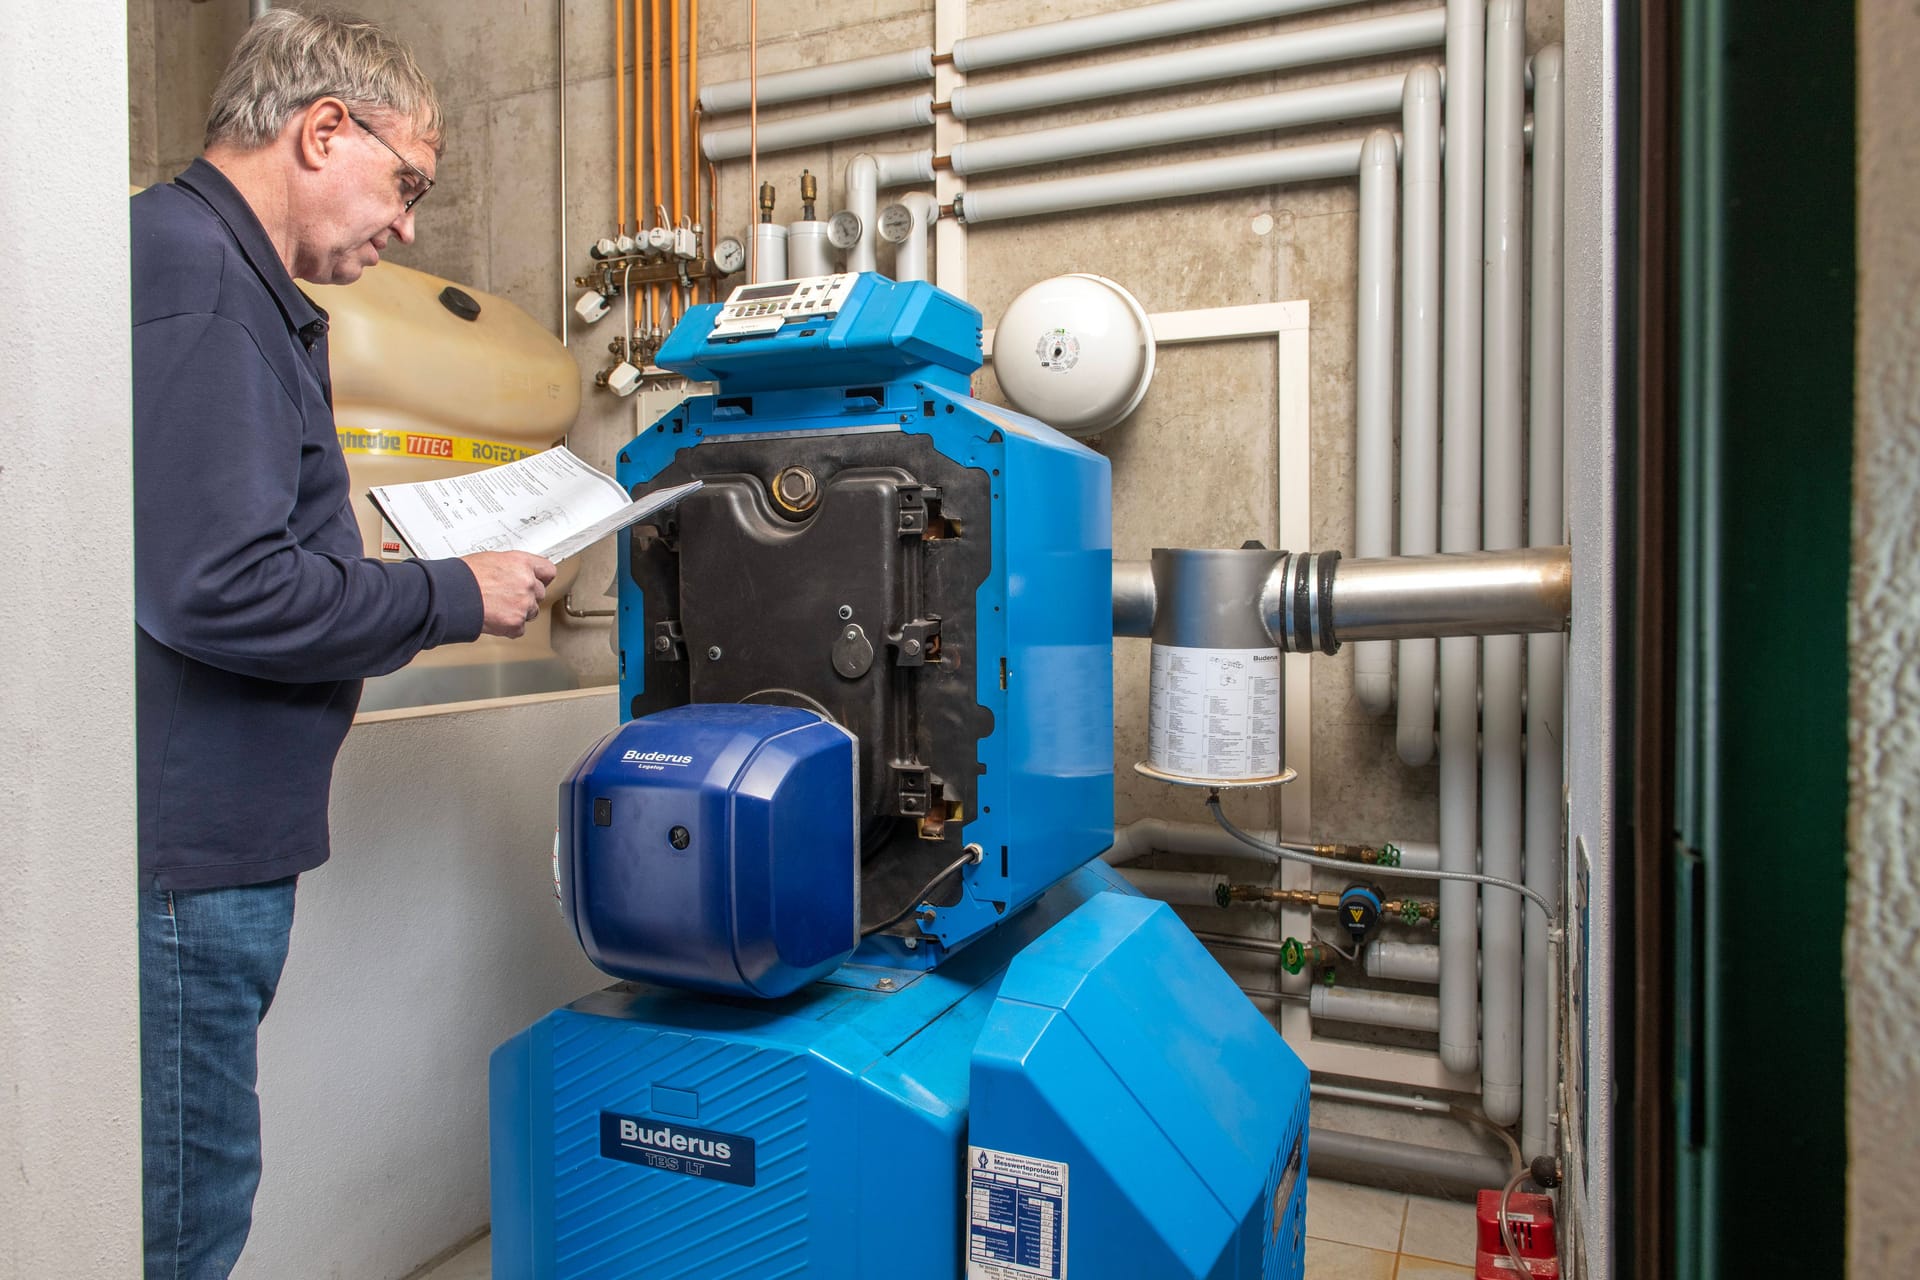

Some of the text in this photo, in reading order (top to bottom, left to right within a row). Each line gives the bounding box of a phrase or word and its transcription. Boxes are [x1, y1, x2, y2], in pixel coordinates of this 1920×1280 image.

[407, 436, 451, 456] TITEC
[472, 442, 516, 463] ROTEX
[622, 750, 693, 764] Buderus
[620, 1119, 731, 1159] Buderus
[645, 1152, 704, 1176] TBS LT
[993, 1159, 1059, 1176] Messwerteprotokoll
